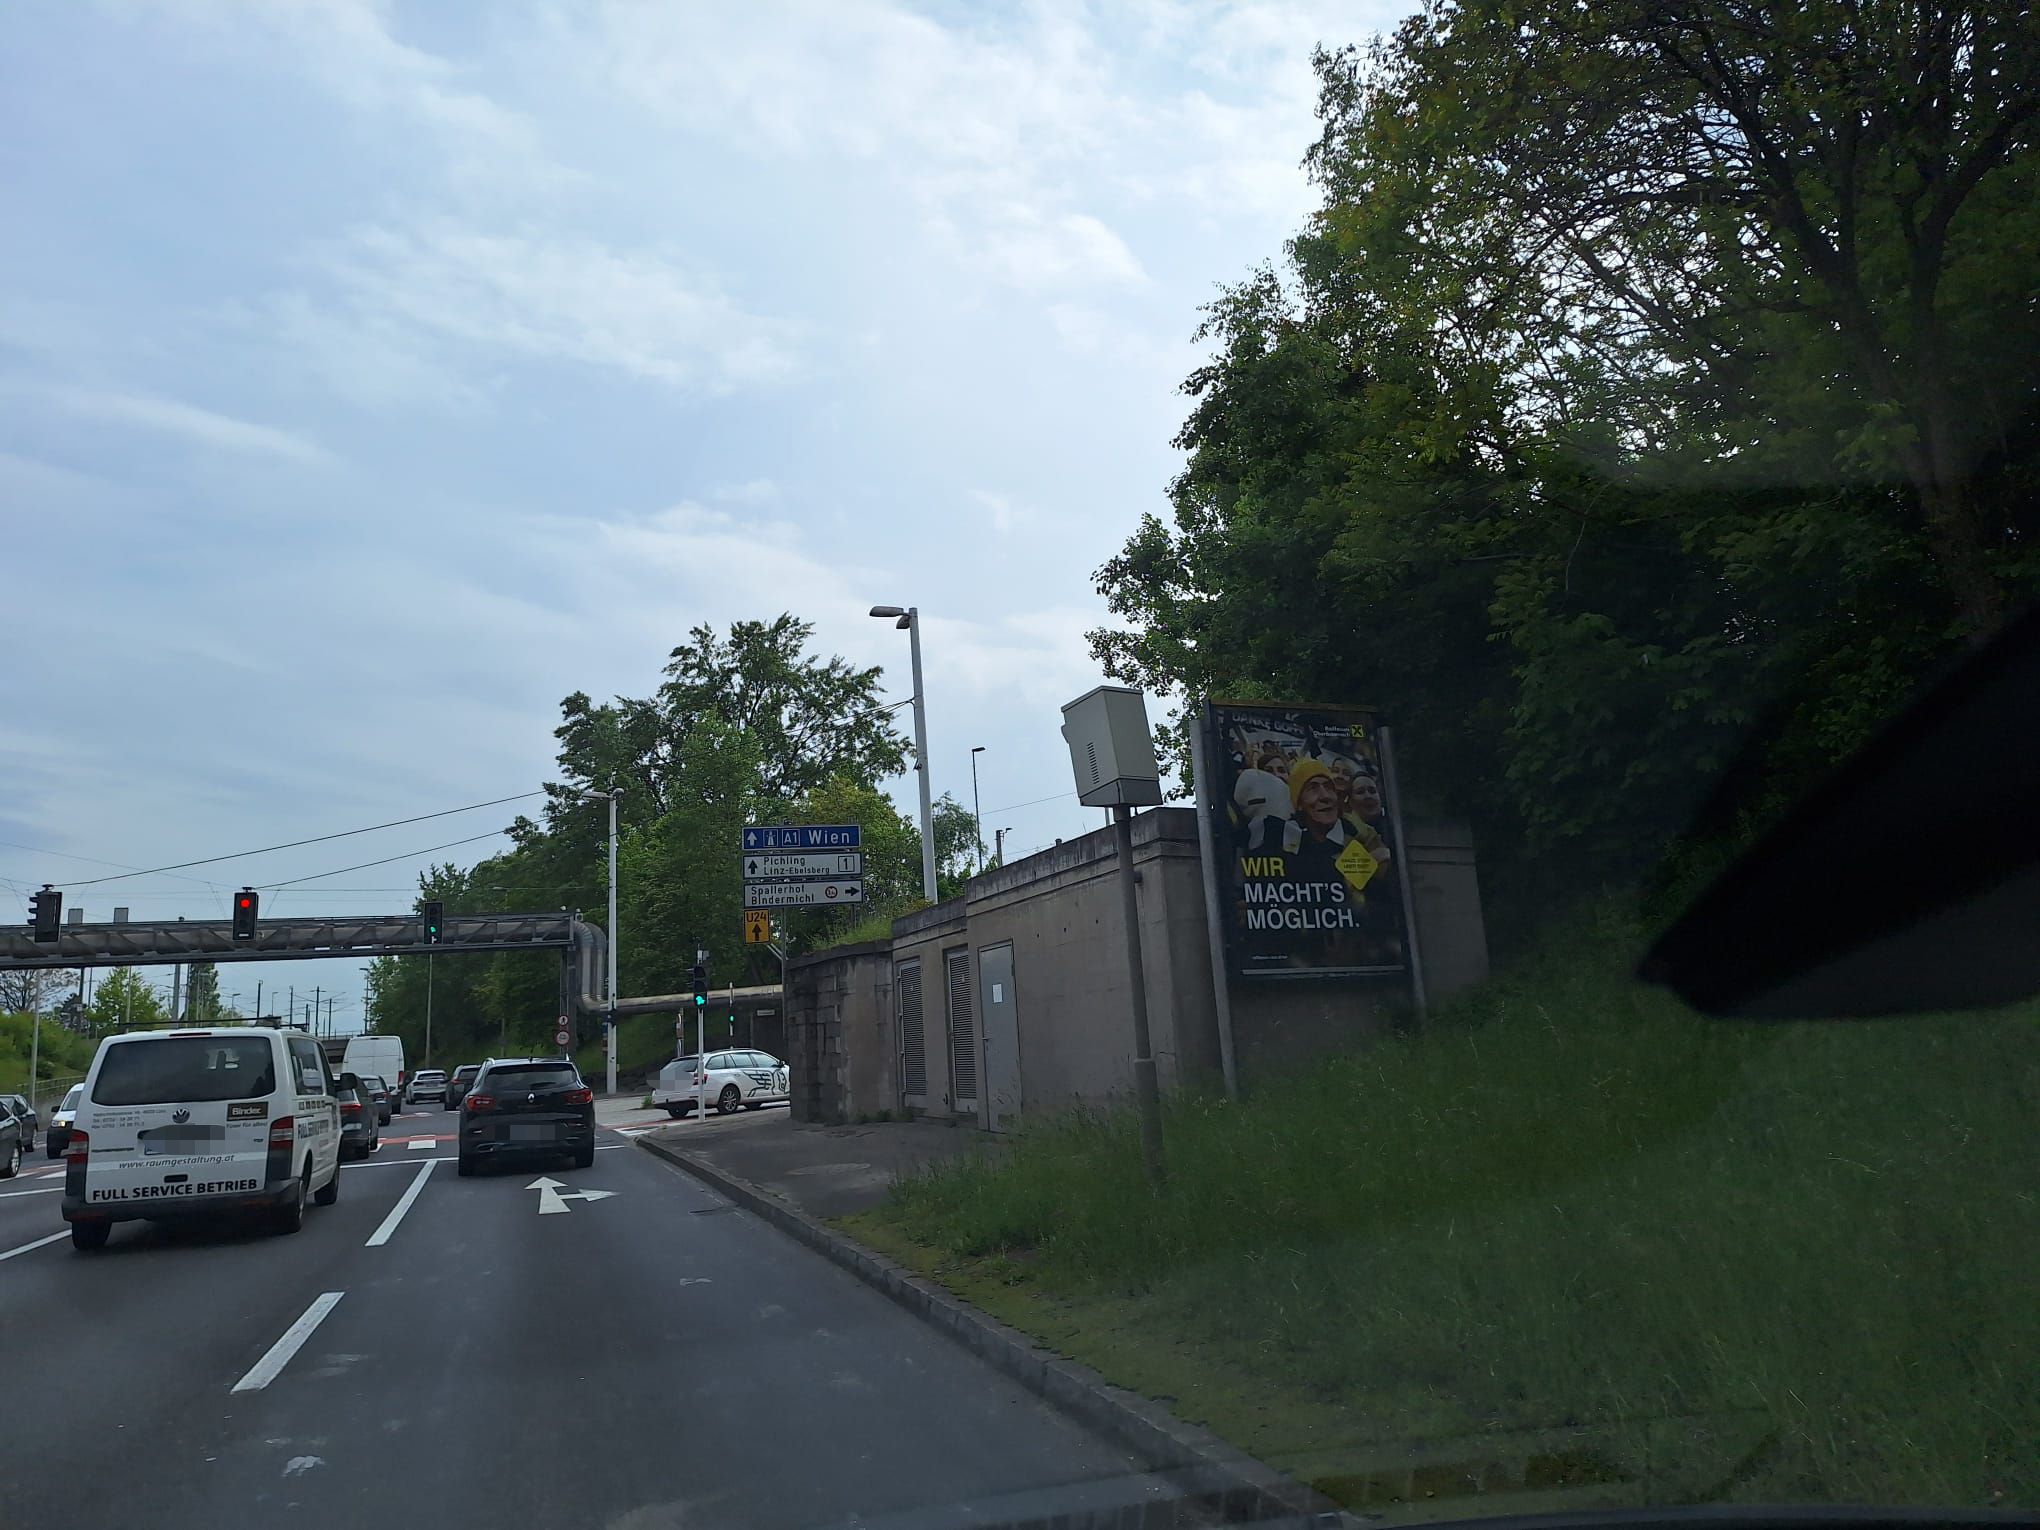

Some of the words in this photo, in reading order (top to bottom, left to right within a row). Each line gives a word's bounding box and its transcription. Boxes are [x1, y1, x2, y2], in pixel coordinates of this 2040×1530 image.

[784, 832, 798, 843] A1
[808, 829, 850, 845] Wien
[763, 856, 806, 866] Pichling
[843, 858, 849, 870] 1
[1240, 857, 1286, 878] WIR
[763, 866, 830, 876] Linz-Ebelsberg
[751, 884, 805, 895] Spallerhof
[1243, 881, 1346, 904] MACHT'S
[751, 893, 815, 905] Bindermichl
[746, 911, 767, 923] U24
[1246, 902, 1361, 930] MÖGLICH.
[231, 1106, 262, 1116] Binder
[118, 1154, 236, 1169] www.raumgestaltung.at
[93, 1188, 129, 1201] FULL
[133, 1183, 193, 1198] SERVICE
[197, 1178, 258, 1194] BETRIEB
